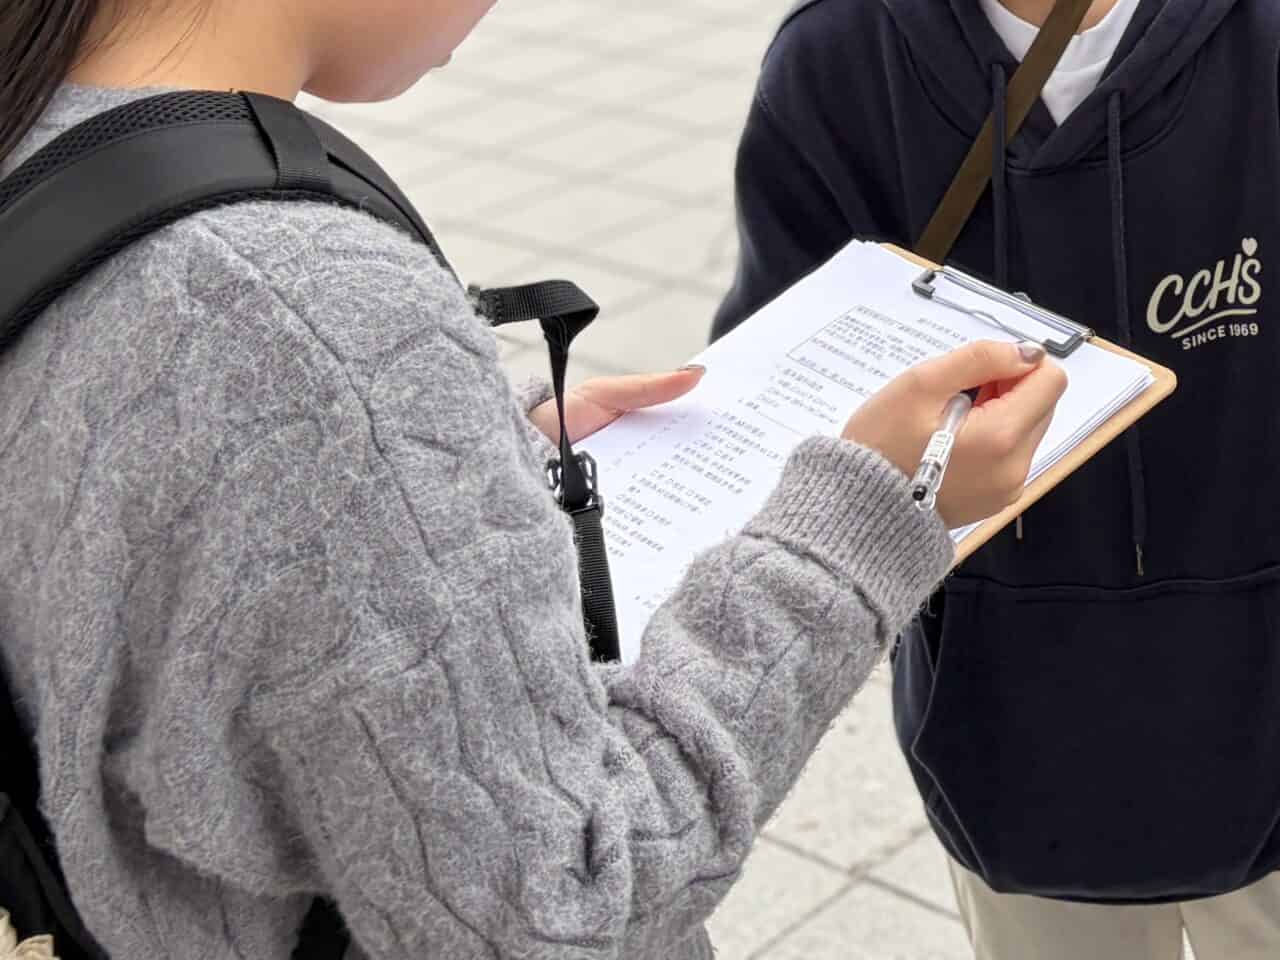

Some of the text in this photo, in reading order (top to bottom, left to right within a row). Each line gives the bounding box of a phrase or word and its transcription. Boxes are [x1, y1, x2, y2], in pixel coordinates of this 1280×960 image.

[1146, 253, 1261, 333] CCHS
[1182, 322, 1258, 350] SINCE 1969
